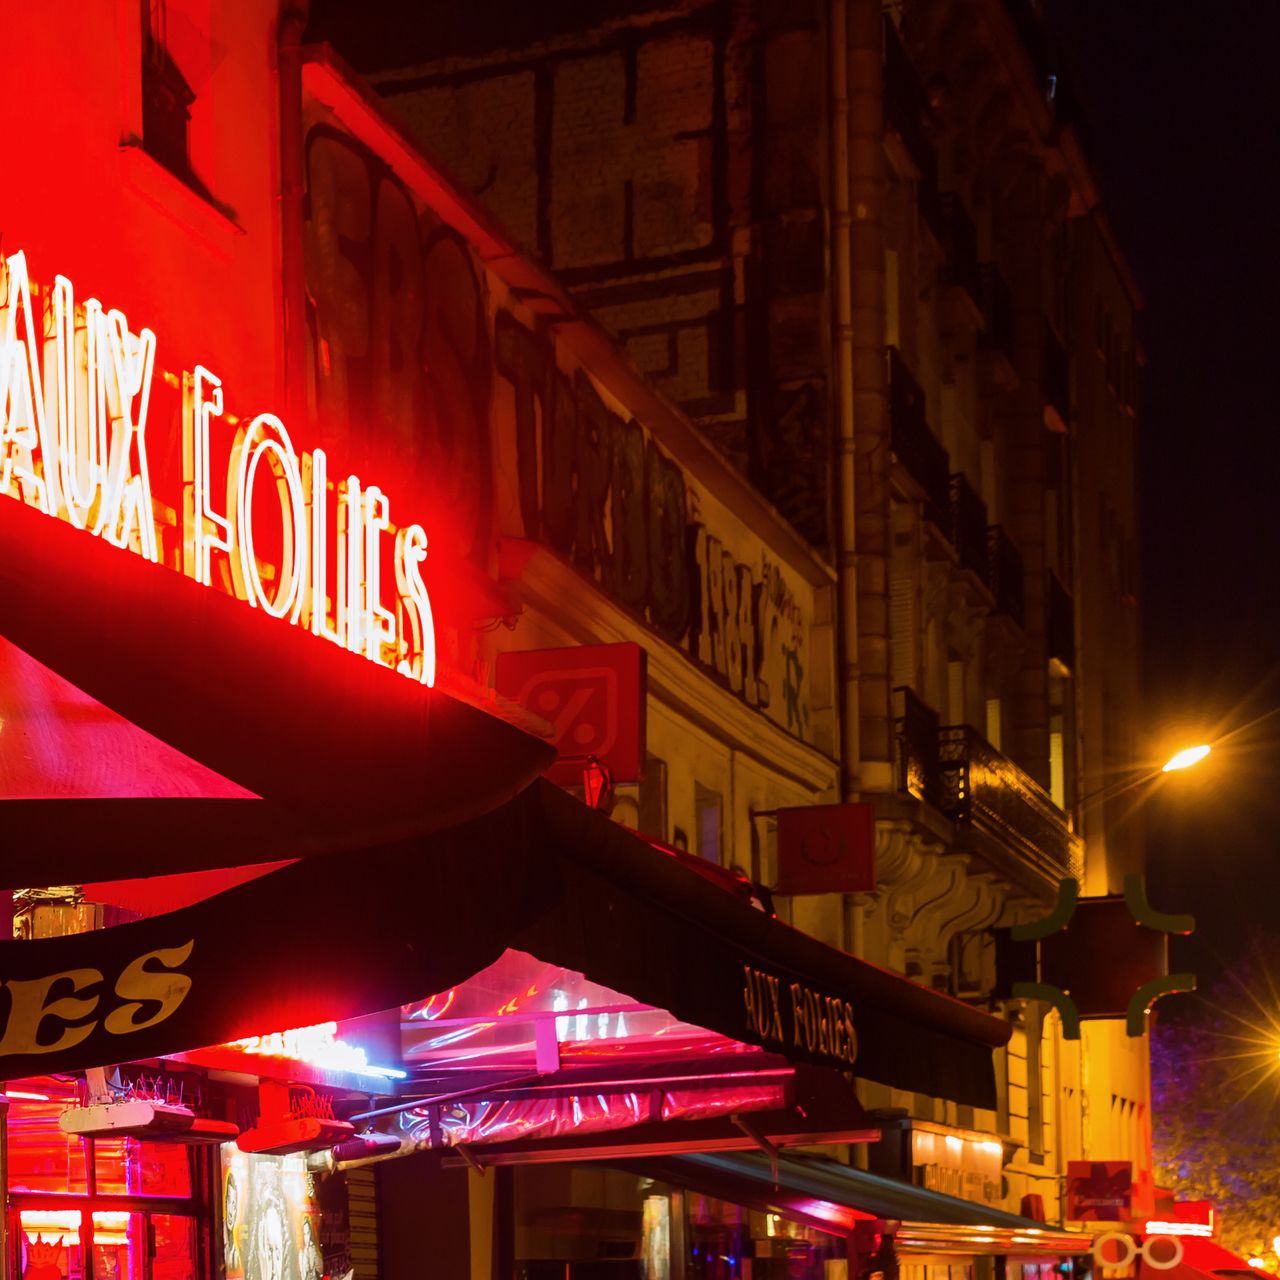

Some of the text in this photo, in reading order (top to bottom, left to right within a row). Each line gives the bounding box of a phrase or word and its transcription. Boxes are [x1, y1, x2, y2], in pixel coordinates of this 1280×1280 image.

[184, 364, 436, 688] FOLIES
[743, 964, 858, 1064] AUX FOLIES
